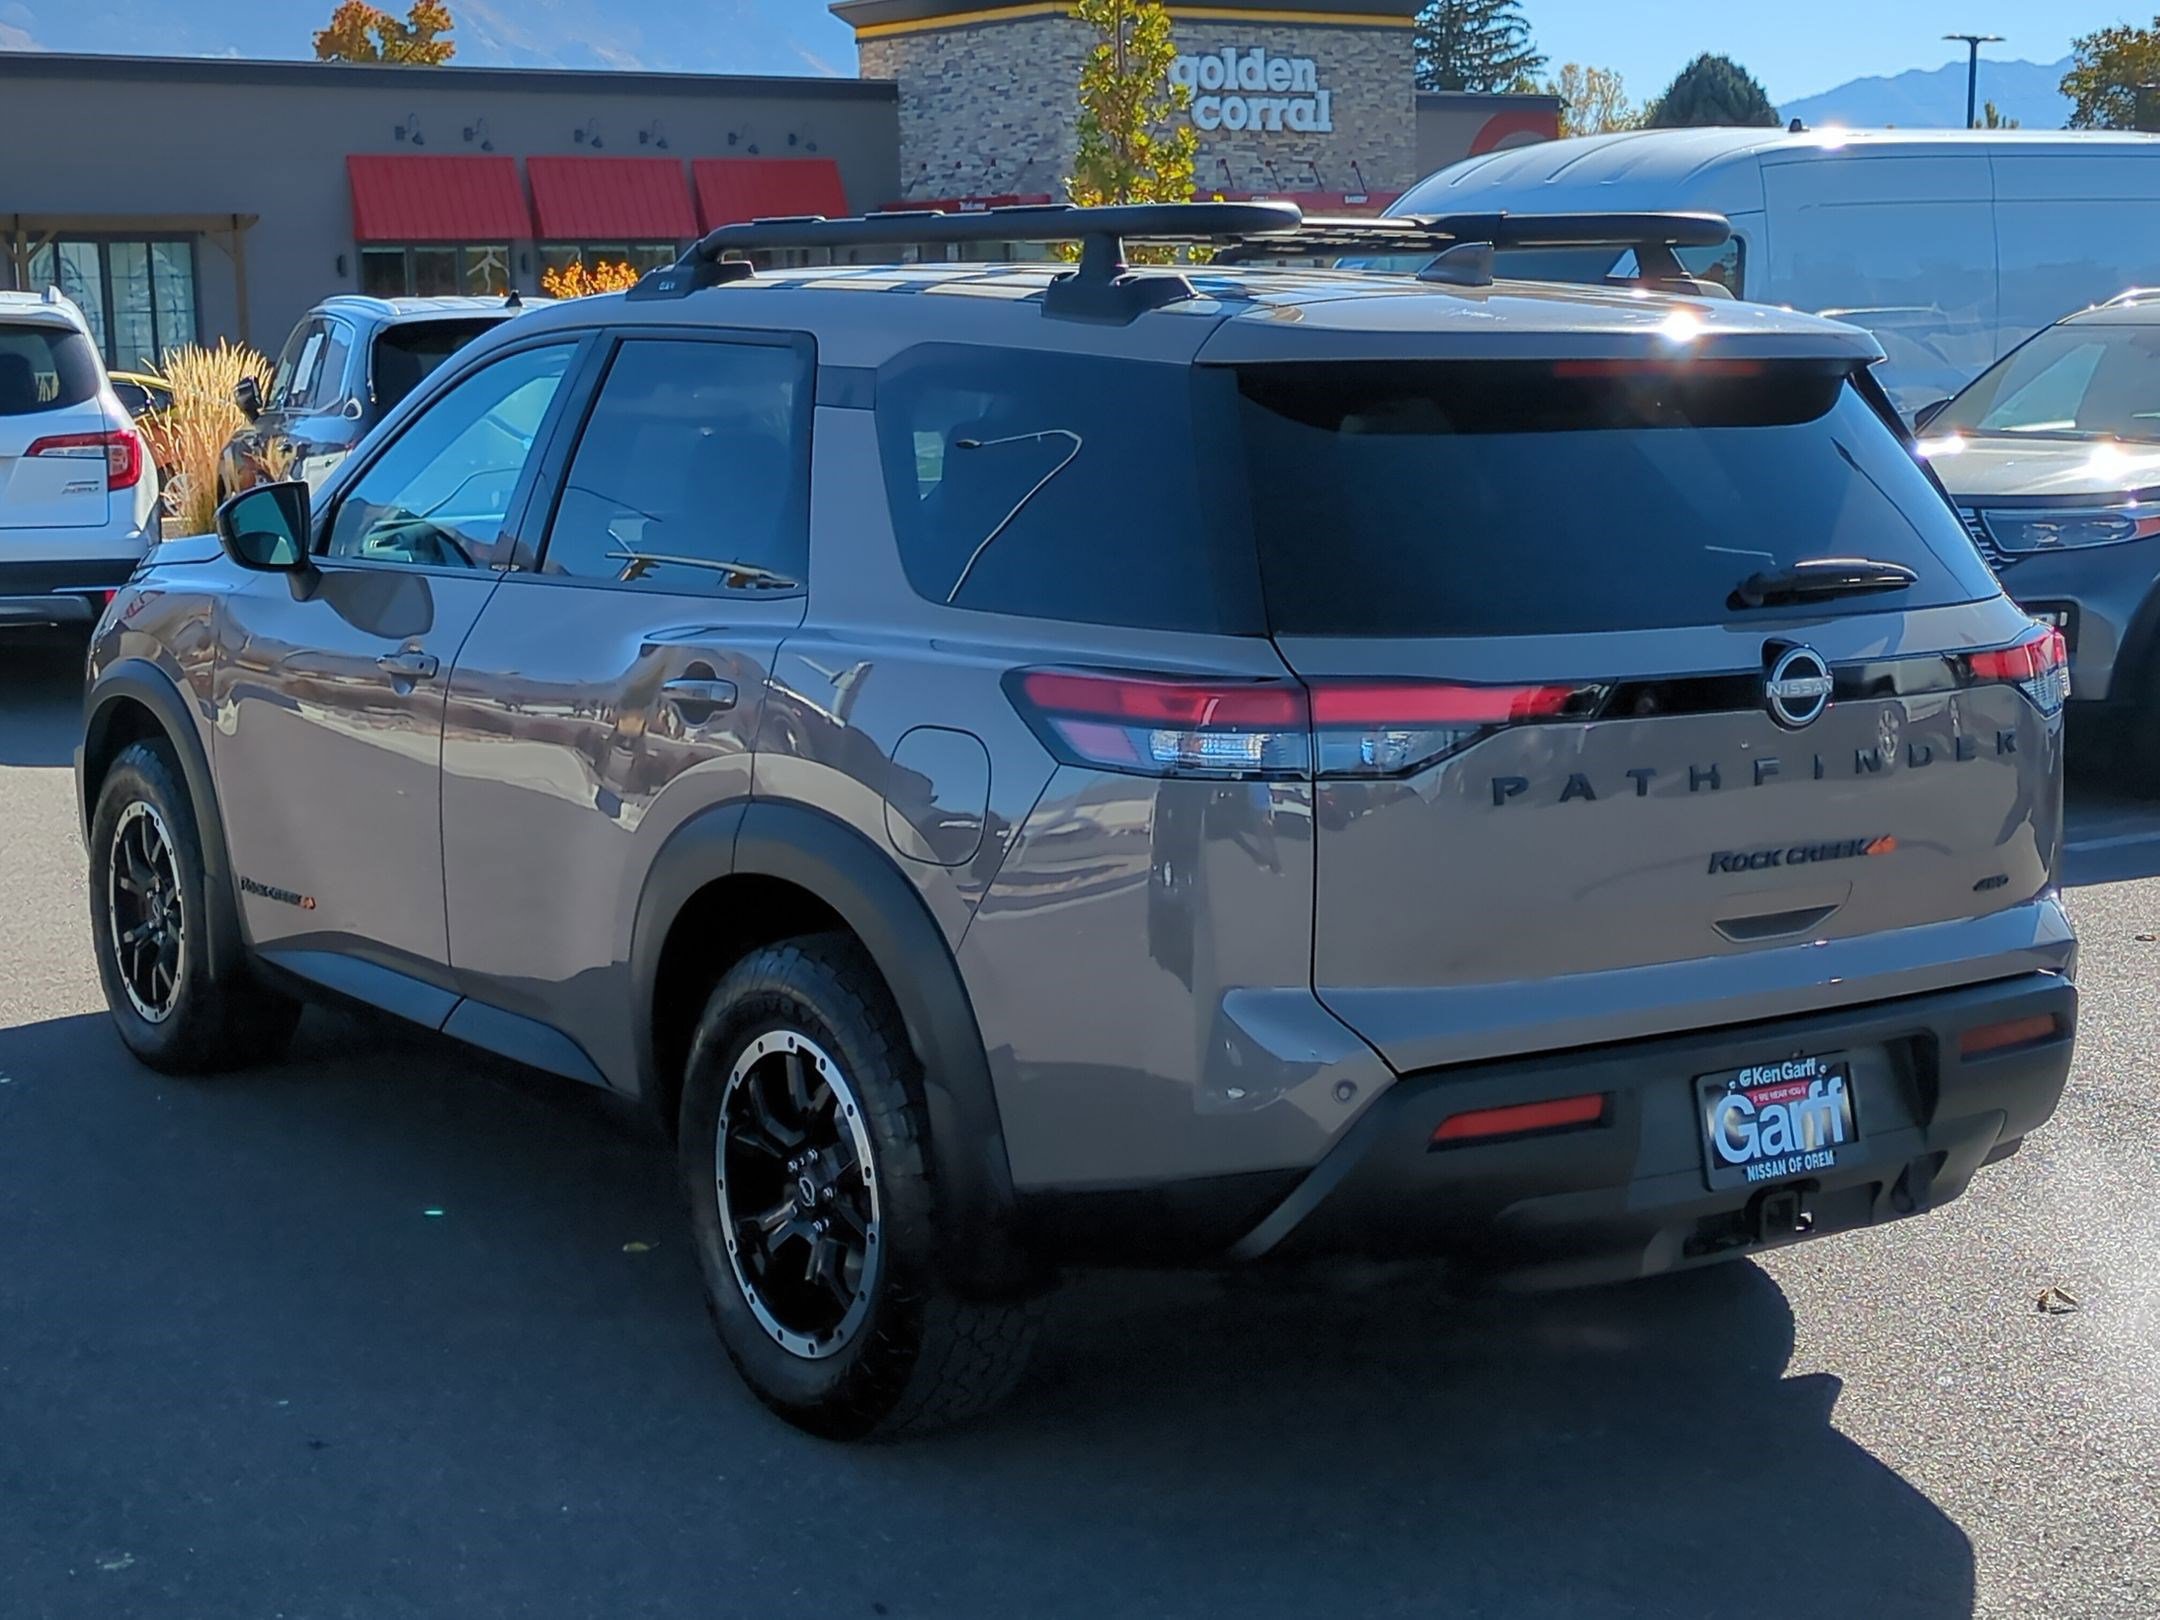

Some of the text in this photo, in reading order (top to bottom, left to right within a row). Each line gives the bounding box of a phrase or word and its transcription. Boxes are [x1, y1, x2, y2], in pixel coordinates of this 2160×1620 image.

[1168, 48, 1317, 99] golden
[1192, 90, 1333, 132] corral
[1769, 680, 1832, 697] NISSAN
[1492, 730, 2016, 806] PATHFINDER
[1708, 838, 1867, 874] ROCK CREEK
[1753, 1058, 1815, 1085] Ken Garff
[1714, 1076, 1844, 1164] Garff
[1746, 1150, 1835, 1182] NISSAN OF OREM
